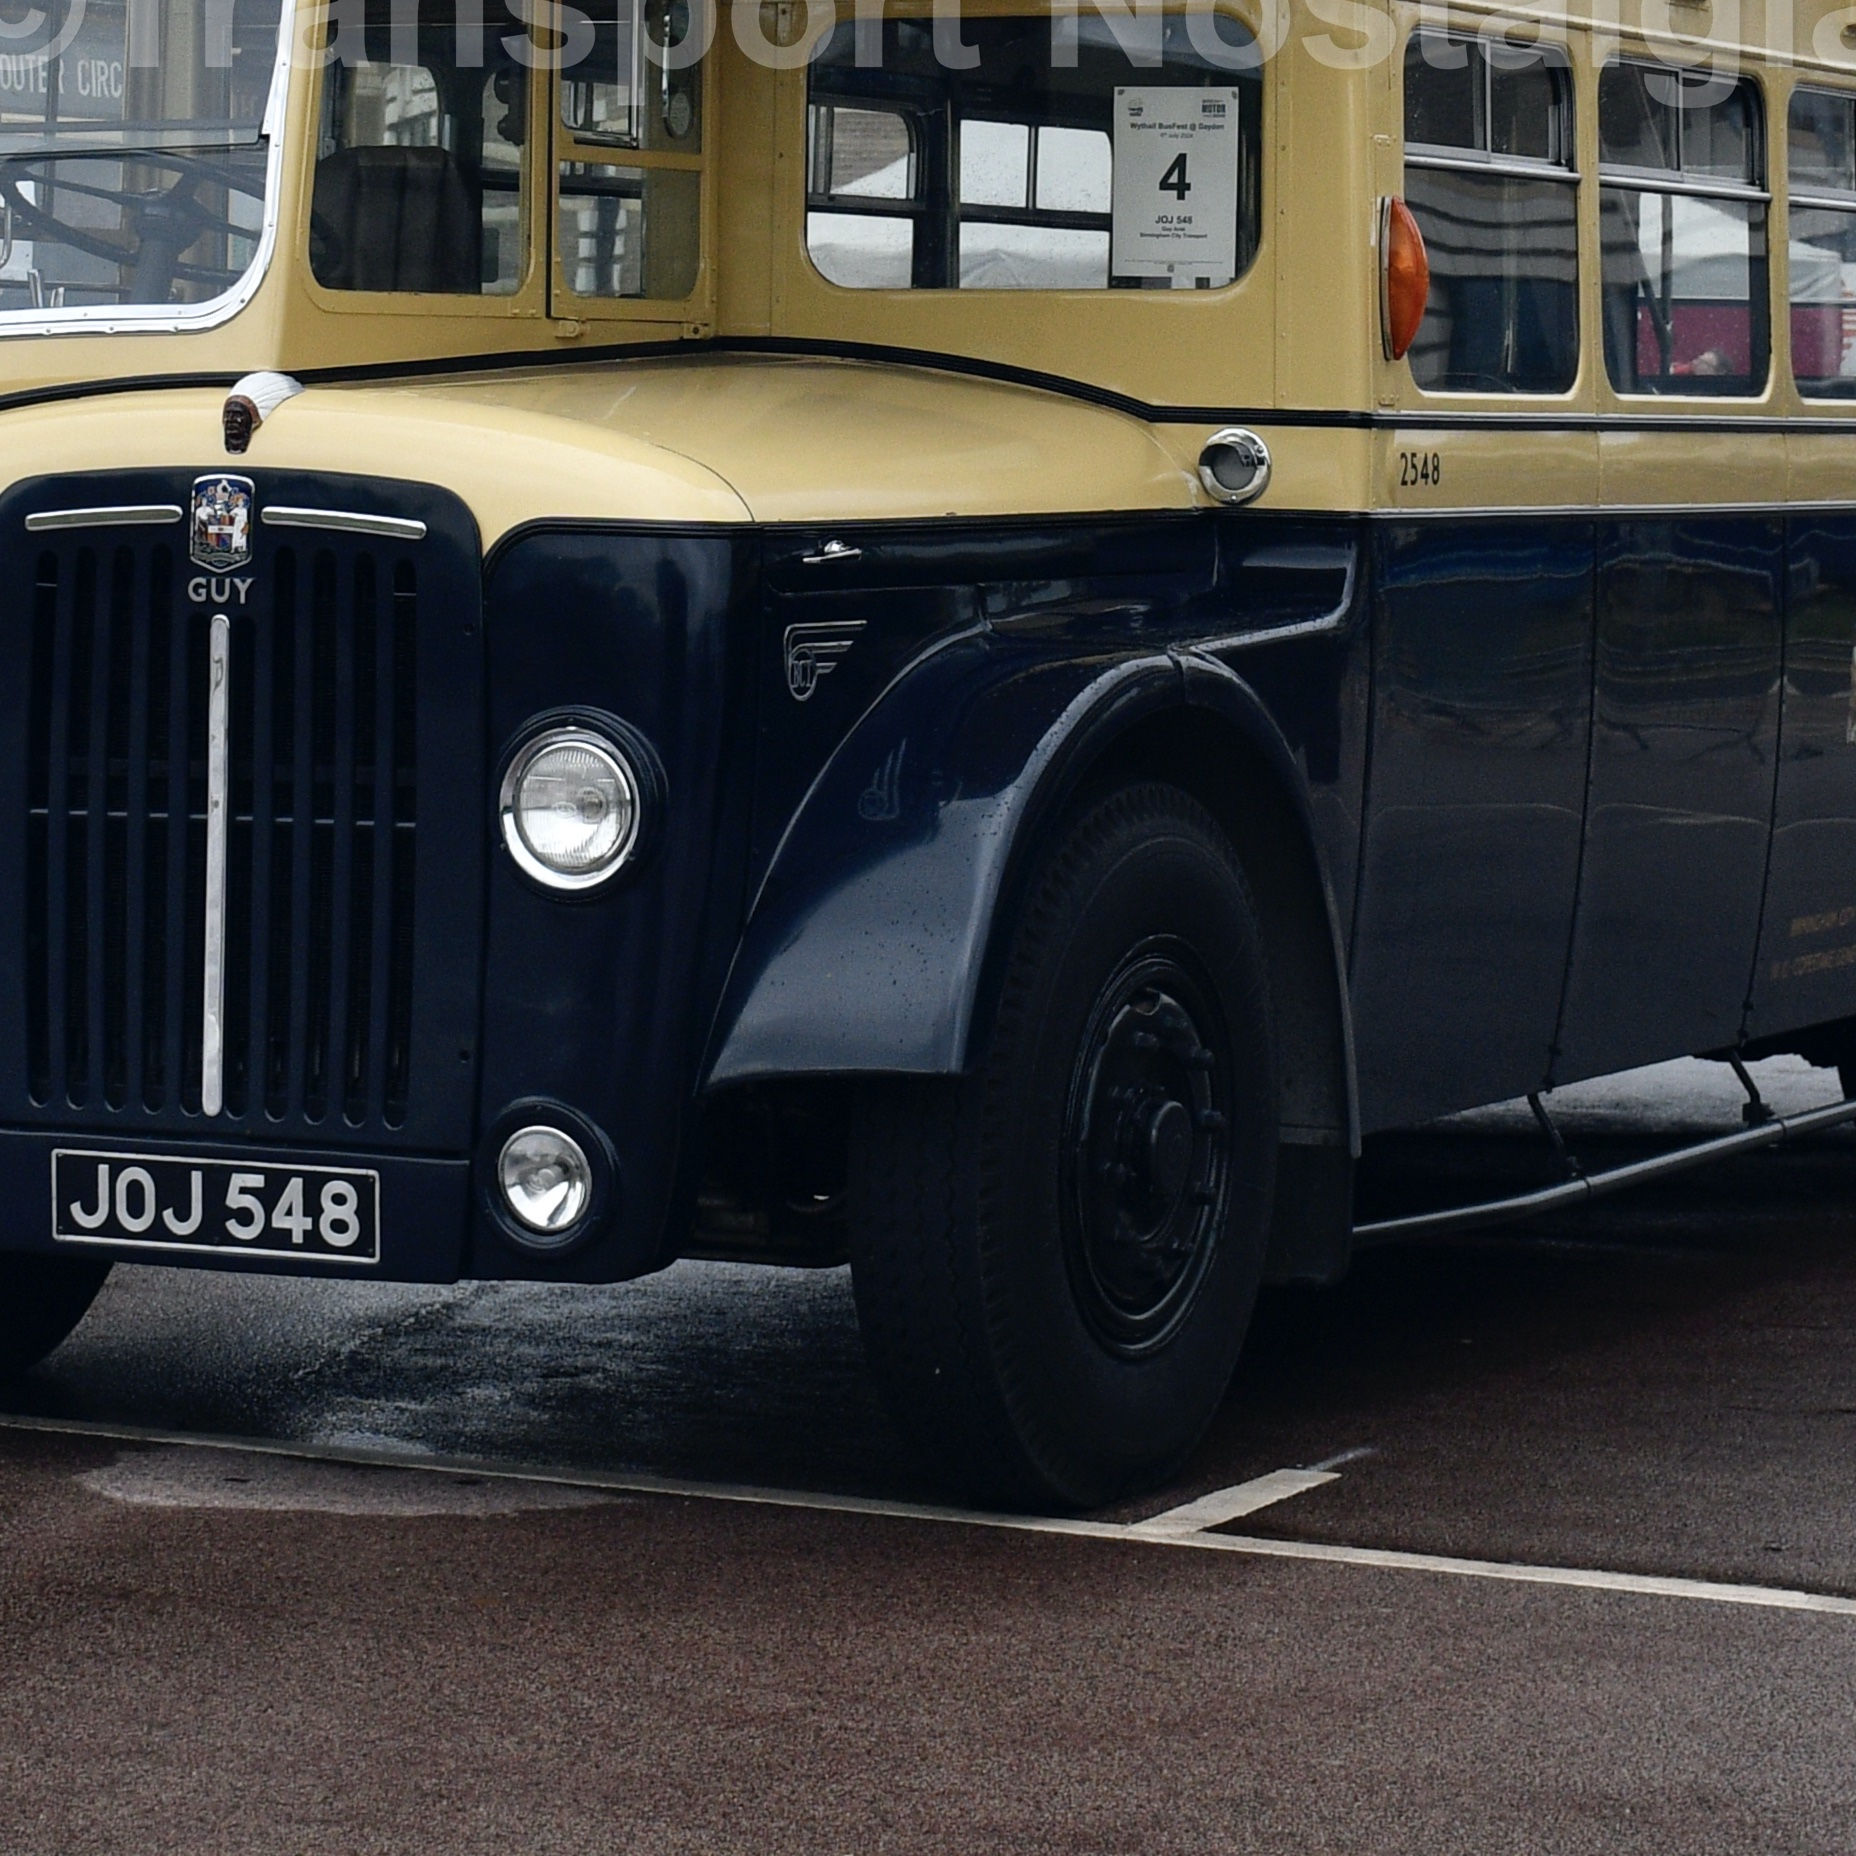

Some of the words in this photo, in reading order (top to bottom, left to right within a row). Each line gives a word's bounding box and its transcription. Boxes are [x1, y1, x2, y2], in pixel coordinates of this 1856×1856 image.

[1159, 153, 1191, 200] 4
[1155, 215, 1173, 224] JOJ
[1177, 216, 1192, 224] 548
[1400, 452, 1440, 486] 2548
[188, 577, 255, 604] GUY
[70, 1164, 202, 1236] JOJ
[225, 1172, 360, 1248] 548
